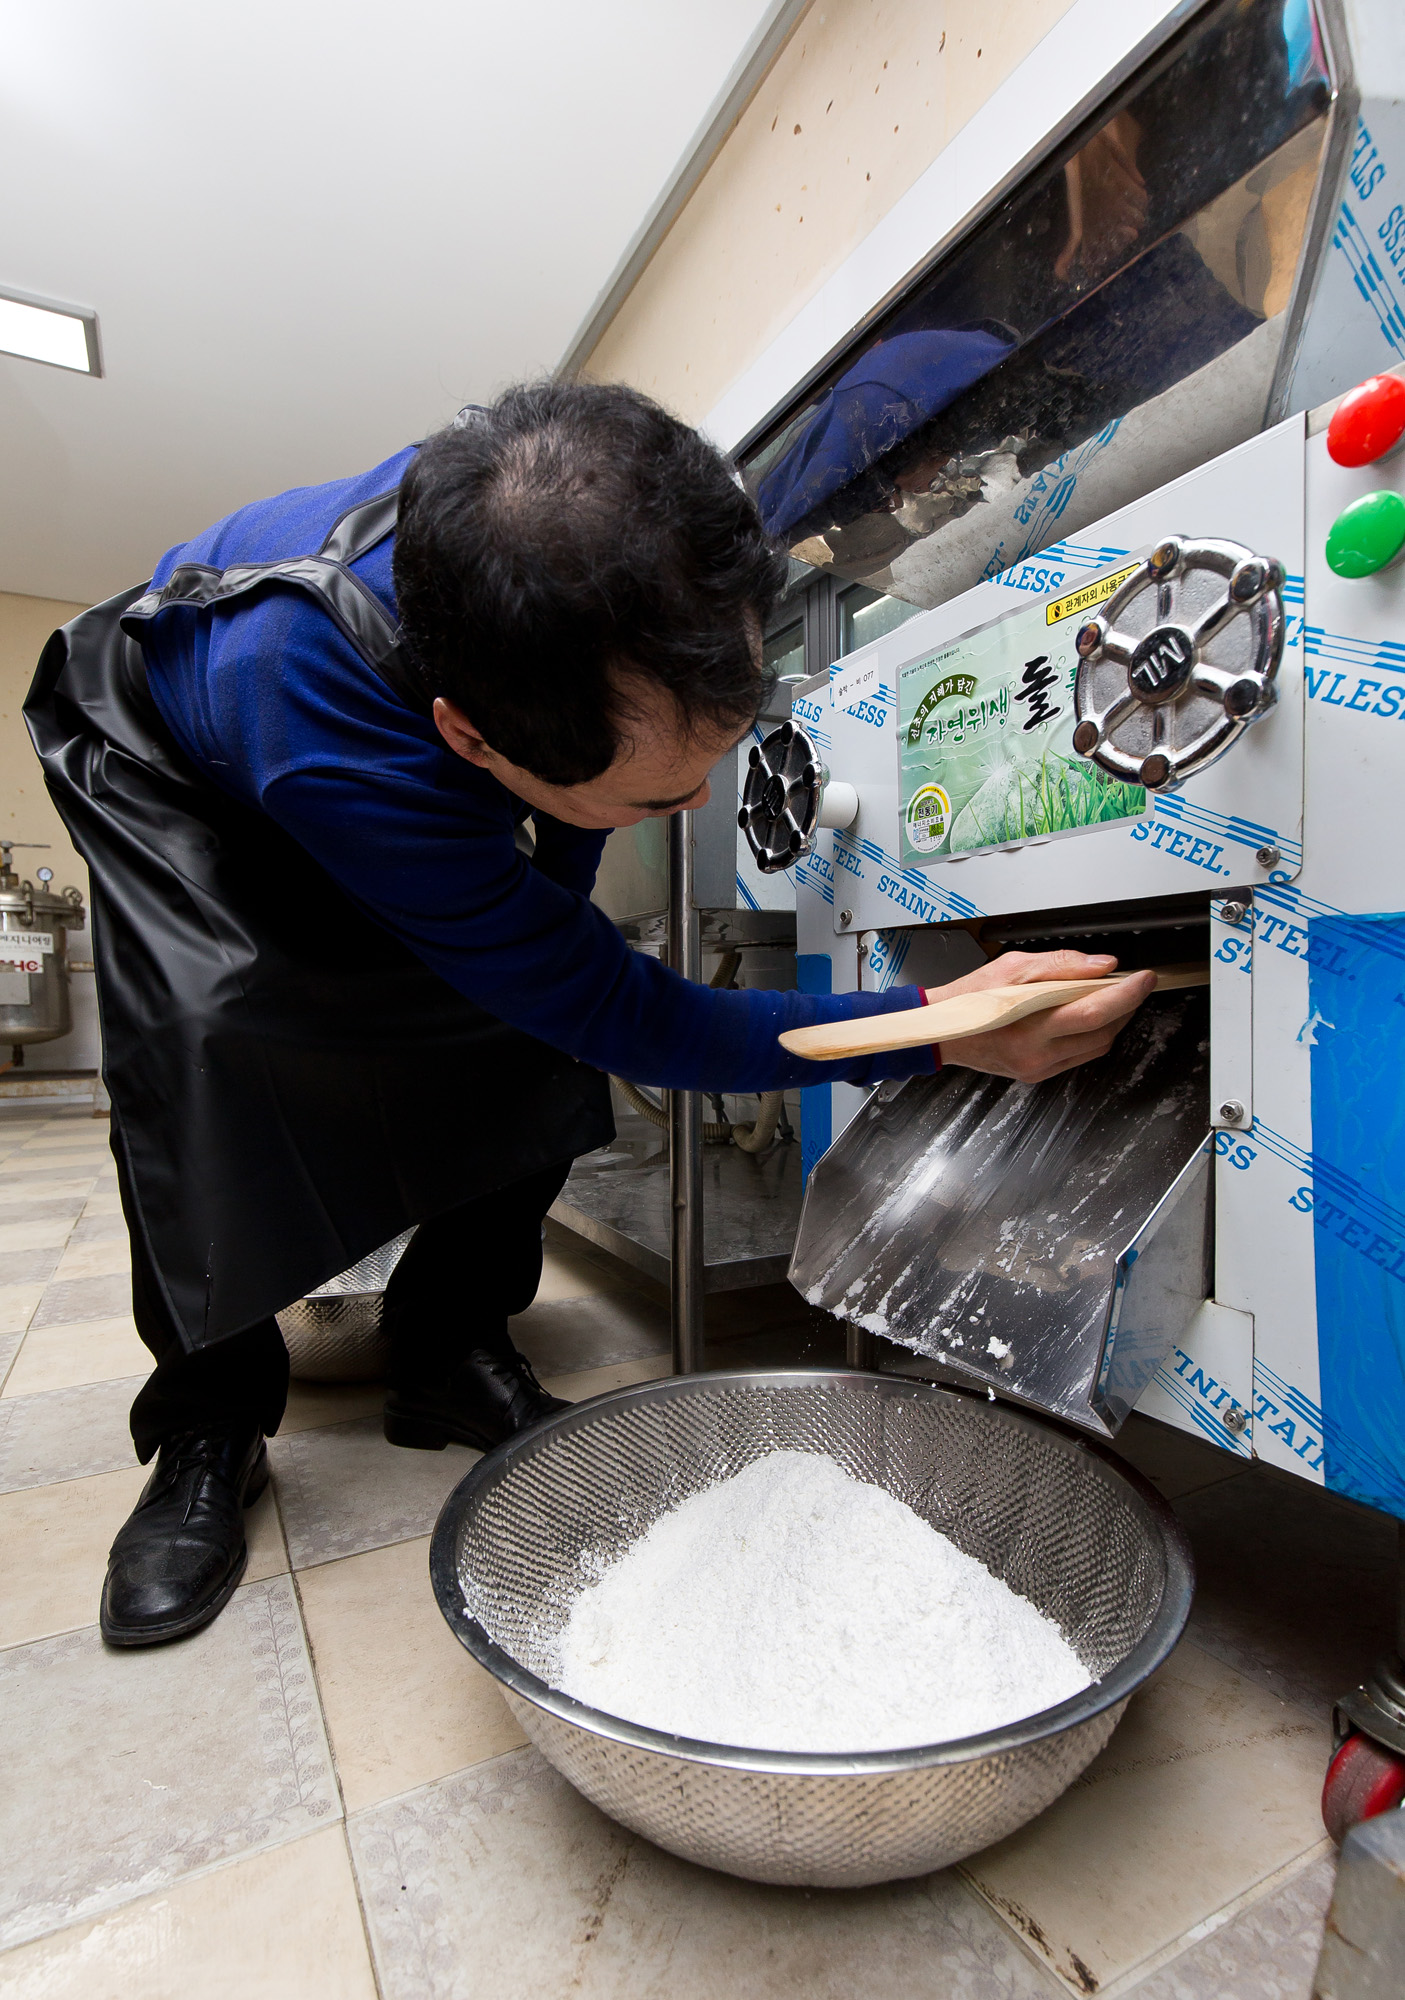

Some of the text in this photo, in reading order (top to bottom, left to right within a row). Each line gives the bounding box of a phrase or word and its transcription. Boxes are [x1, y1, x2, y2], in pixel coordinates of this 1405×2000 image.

[1065, 587, 1098, 612] 관계자외
[957, 676, 975, 696] 담긴
[926, 687, 1009, 743] 자연위생
[1130, 820, 1231, 877] STEEL.
